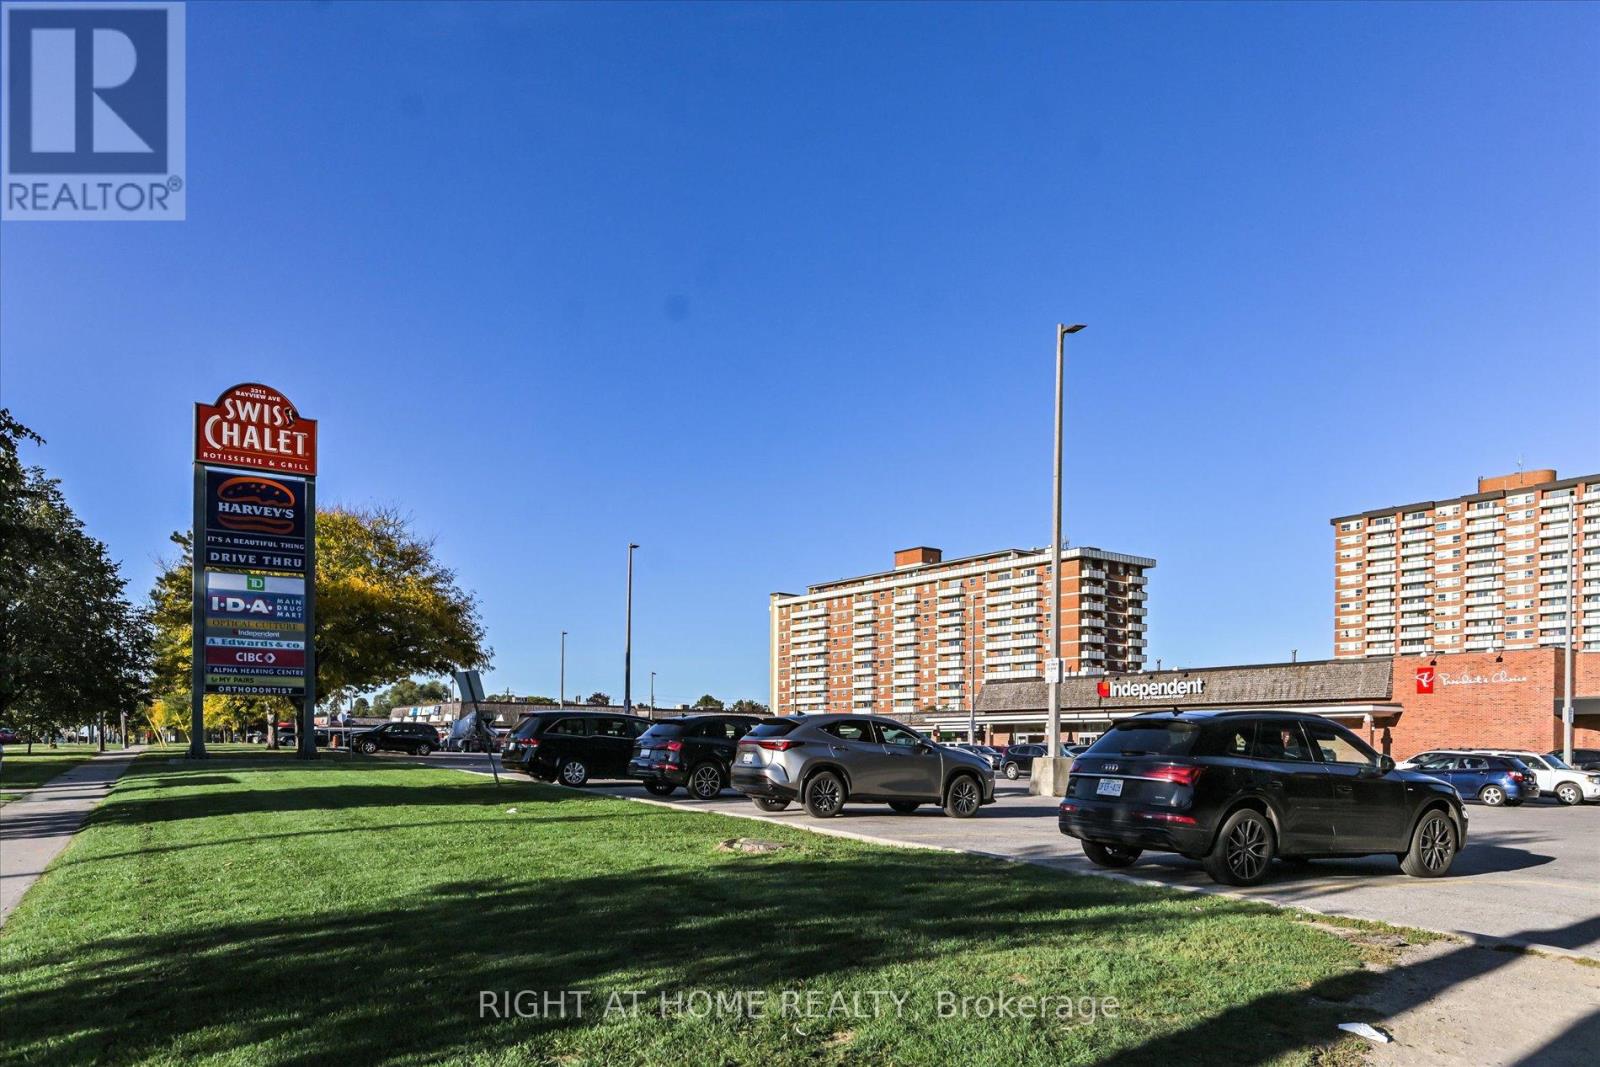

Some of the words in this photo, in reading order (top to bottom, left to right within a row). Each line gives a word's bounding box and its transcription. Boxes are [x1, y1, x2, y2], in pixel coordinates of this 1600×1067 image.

[235, 390, 267, 399] BAYVIEW
[204, 414, 309, 455] CHALET
[203, 451, 262, 465] ROTISSERIE
[280, 461, 309, 470] GRILL
[217, 501, 295, 519] HARVEY'S
[207, 535, 223, 543] IT'S
[233, 538, 278, 548] BEAUTIFUL
[280, 542, 305, 550] THING
[210, 552, 257, 564] DRIVE
[262, 556, 302, 568] THRU
[248, 578, 263, 588] TD
[238, 629, 280, 639] Independent
[221, 638, 274, 648] Edwards
[235, 652, 263, 662] CIBC
[240, 667, 274, 675] HEARING
[218, 685, 293, 694] ORTHODONTIST
[1109, 677, 1205, 700] Independent
